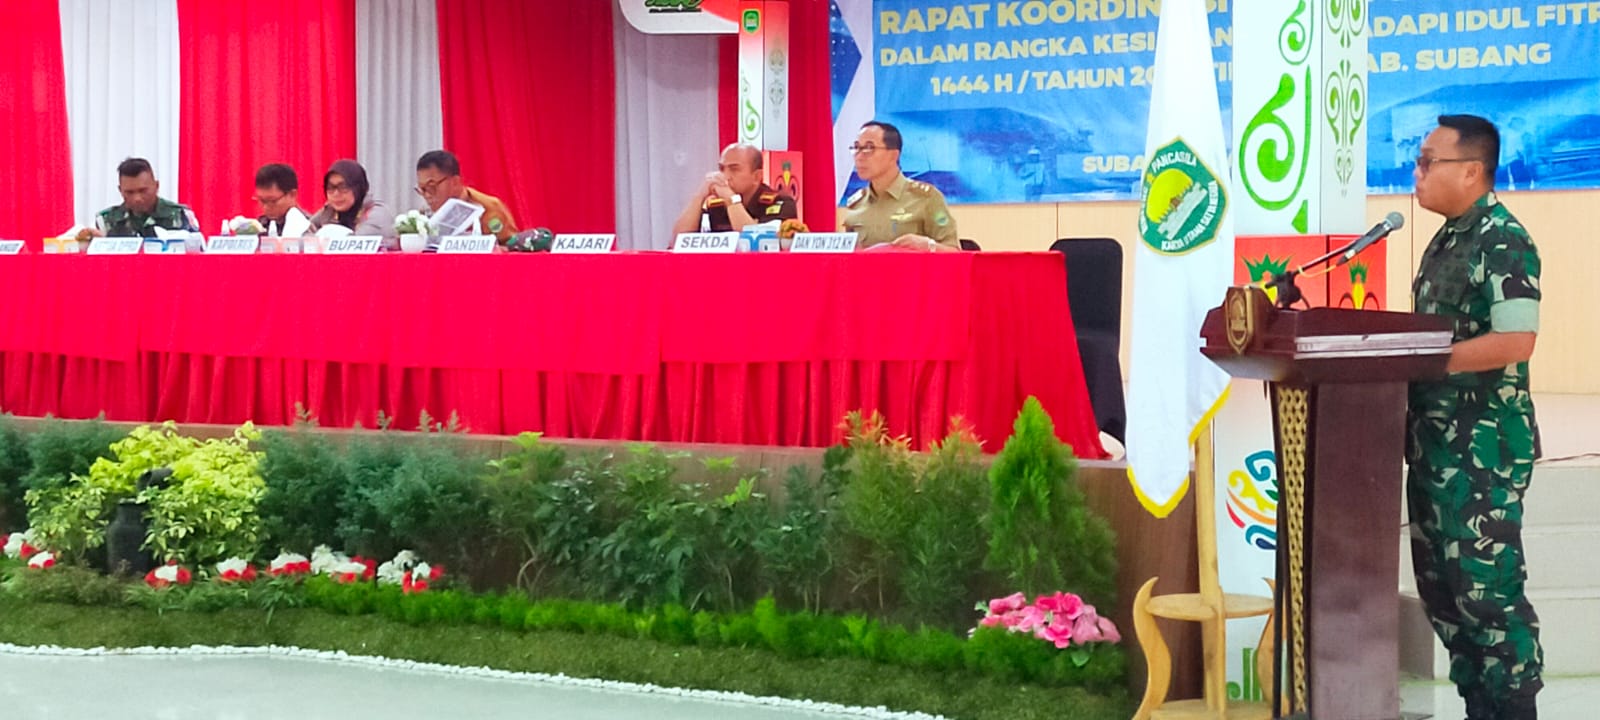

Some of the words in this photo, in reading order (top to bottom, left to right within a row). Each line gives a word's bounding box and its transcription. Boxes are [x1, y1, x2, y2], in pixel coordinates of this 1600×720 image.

[880, 4, 990, 34] RAPAT
[880, 43, 968, 66] DALAM
[974, 36, 1088, 60] RANGKA
[1455, 7, 1530, 32] IDUL
[930, 75, 990, 96] 1444
[994, 72, 1013, 93] H
[1017, 70, 1029, 94] /
[1031, 67, 1125, 91] TAHUN
[1415, 43, 1551, 71] SUBANG
[1083, 154, 1144, 174] SUBA
[1151, 151, 1197, 173] PANCASILA
[328, 239, 379, 251] BUPATI
[444, 239, 491, 251] DANDIM
[555, 237, 611, 250] KAJARI
[680, 236, 731, 249] SEKDA
